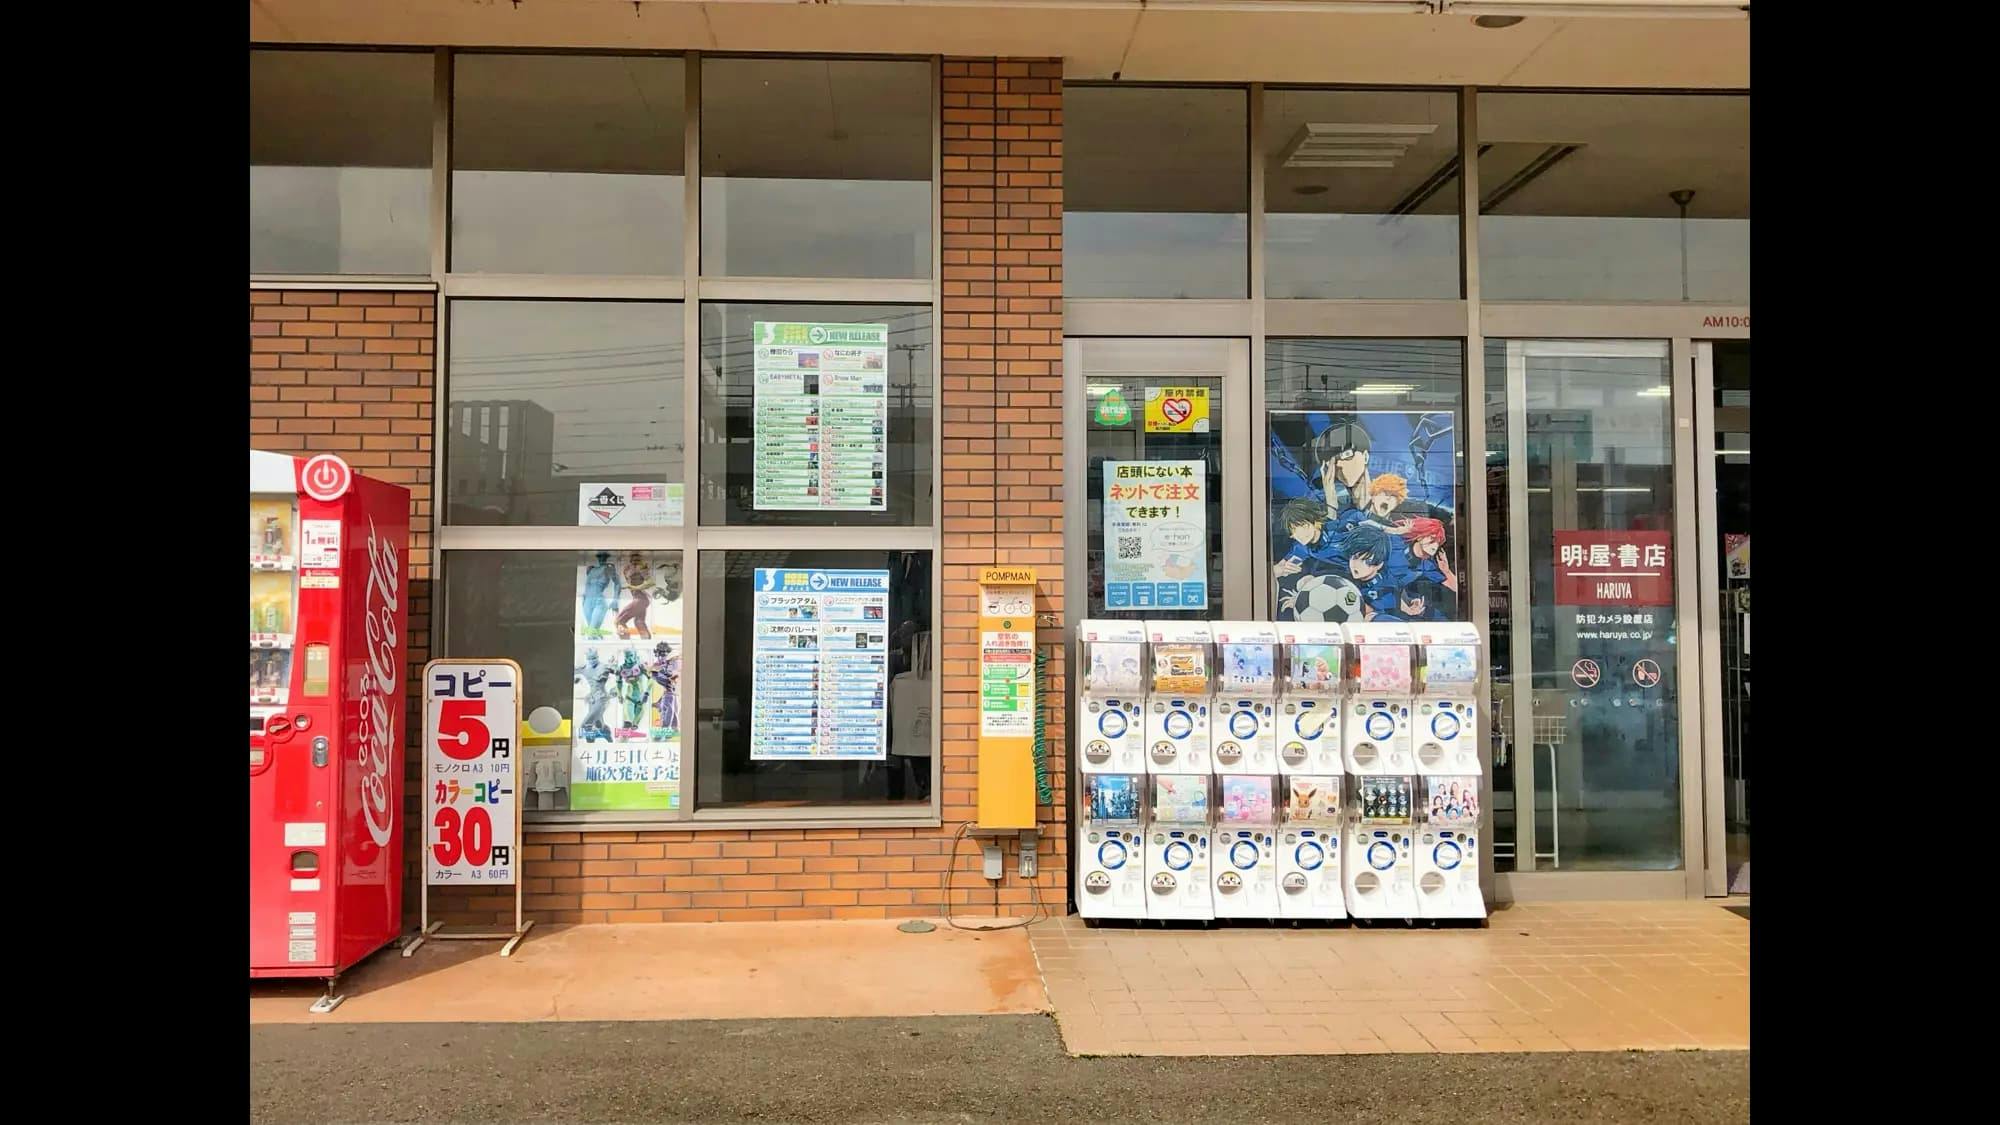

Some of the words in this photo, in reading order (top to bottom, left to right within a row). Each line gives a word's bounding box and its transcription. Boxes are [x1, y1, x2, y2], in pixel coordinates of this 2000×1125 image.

[829, 330, 848, 341] NEW
[848, 331, 880, 341] RELEASE
[1117, 465, 1193, 478] 店頭にない本
[1110, 483, 1200, 500] ネットで注文
[986, 572, 1031, 581] POMPMAN
[831, 578, 849, 587] NEW
[850, 578, 882, 587] RELEASE
[1596, 582, 1632, 599] HARUYA
[1576, 614, 1654, 624] 防犯カメラ設置店
[1576, 630, 1653, 640] www.haruya.co.jp/
[434, 669, 512, 698] コピー
[434, 763, 470, 773] モノクロ
[472, 764, 483, 773] A3
[490, 764, 510, 773] 10円
[585, 766, 679, 781] 順次発売予定
[434, 779, 512, 804] カラーコピー
[435, 871, 462, 879] カラー
[471, 870, 482, 879] A3
[488, 870, 509, 879] 60円
